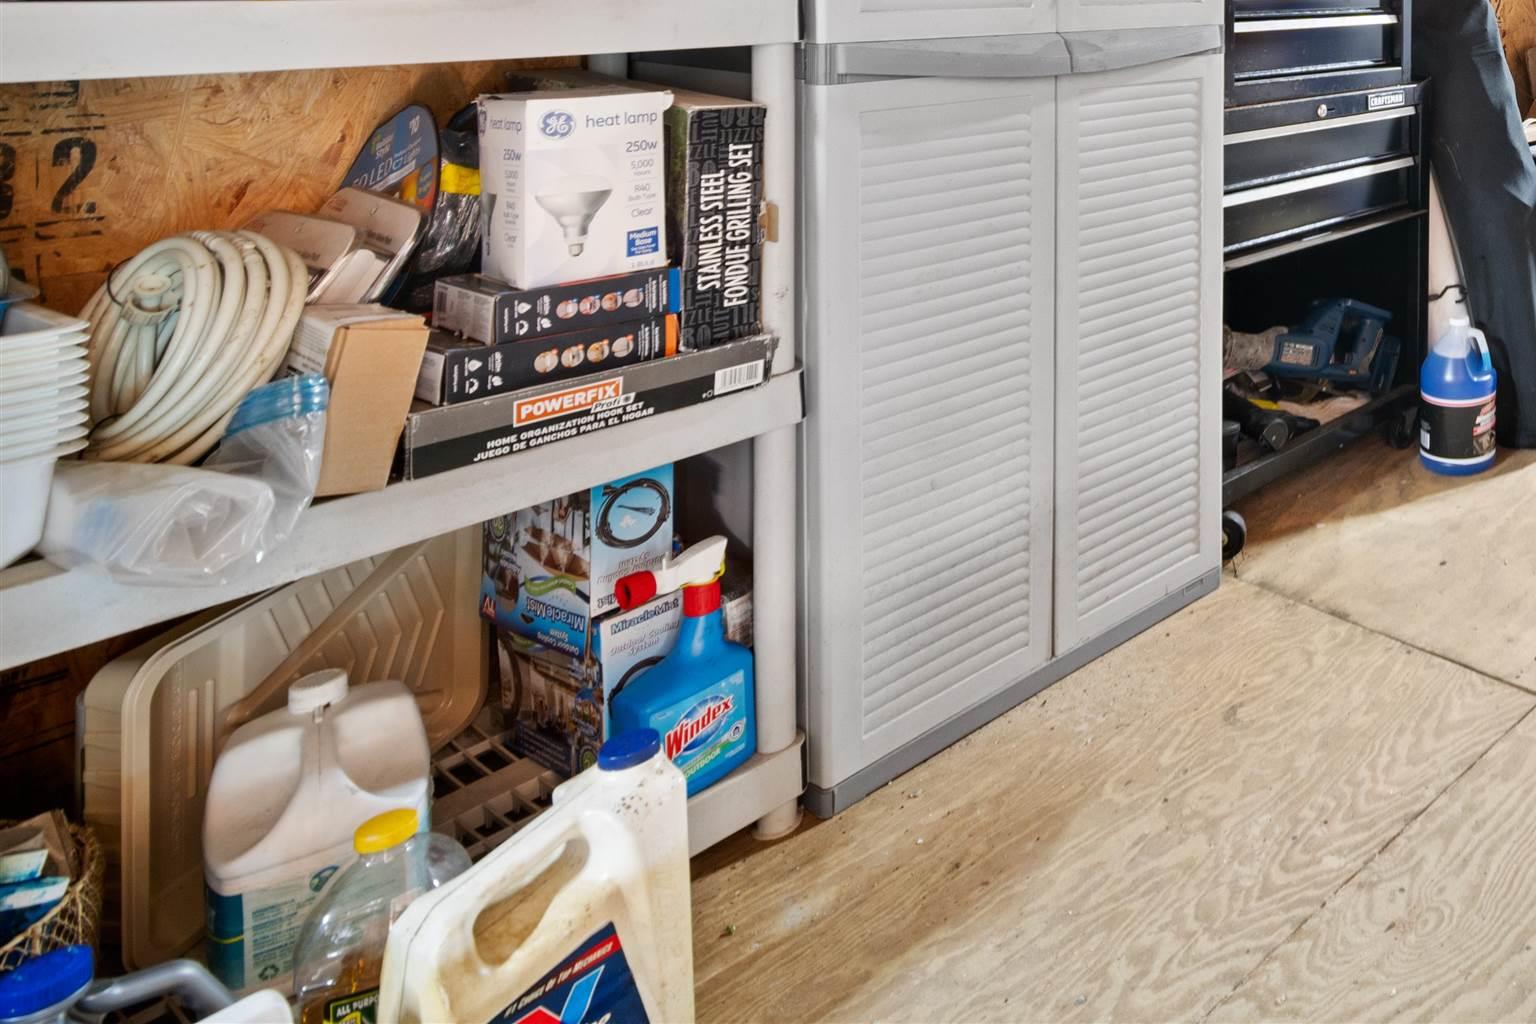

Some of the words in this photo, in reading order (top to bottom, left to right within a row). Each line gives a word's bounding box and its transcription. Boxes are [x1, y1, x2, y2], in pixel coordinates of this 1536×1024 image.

[1370, 93, 1404, 108] CRAFTSMAN
[503, 119, 522, 135] lamp
[585, 114, 620, 128] heat
[624, 111, 658, 126] lamp
[625, 140, 657, 154] 250w
[728, 143, 753, 173] SET
[369, 157, 393, 186] LED
[700, 169, 725, 212] STEEL
[631, 207, 654, 218] Clear
[726, 174, 752, 244] GRILLING
[629, 229, 657, 240] Medium
[698, 213, 724, 291] STAINLESS
[723, 244, 750, 308] FONDUE
[520, 380, 620, 419] POWERFIX
[593, 397, 621, 412] Profi
[473, 446, 511, 462] JUEGO
[513, 441, 527, 451] DE
[529, 427, 577, 447] GANCHOS
[579, 419, 607, 433] PARA
[608, 415, 620, 426] EL
[622, 407, 655, 423] HOGAR
[486, 435, 518, 449] HOME
[520, 414, 596, 441] ORGANIZATION
[597, 408, 624, 421] HOOK
[627, 401, 645, 413] SET
[526, 597, 585, 633] MiracleMist
[611, 598, 679, 636] MiracleMist
[665, 695, 734, 762] Windex
[519, 988, 544, 1010] CHOICE
[573, 941, 614, 976] MECHANICS
[336, 1004, 351, 1018] ALL
[352, 994, 379, 1011] PURPO
